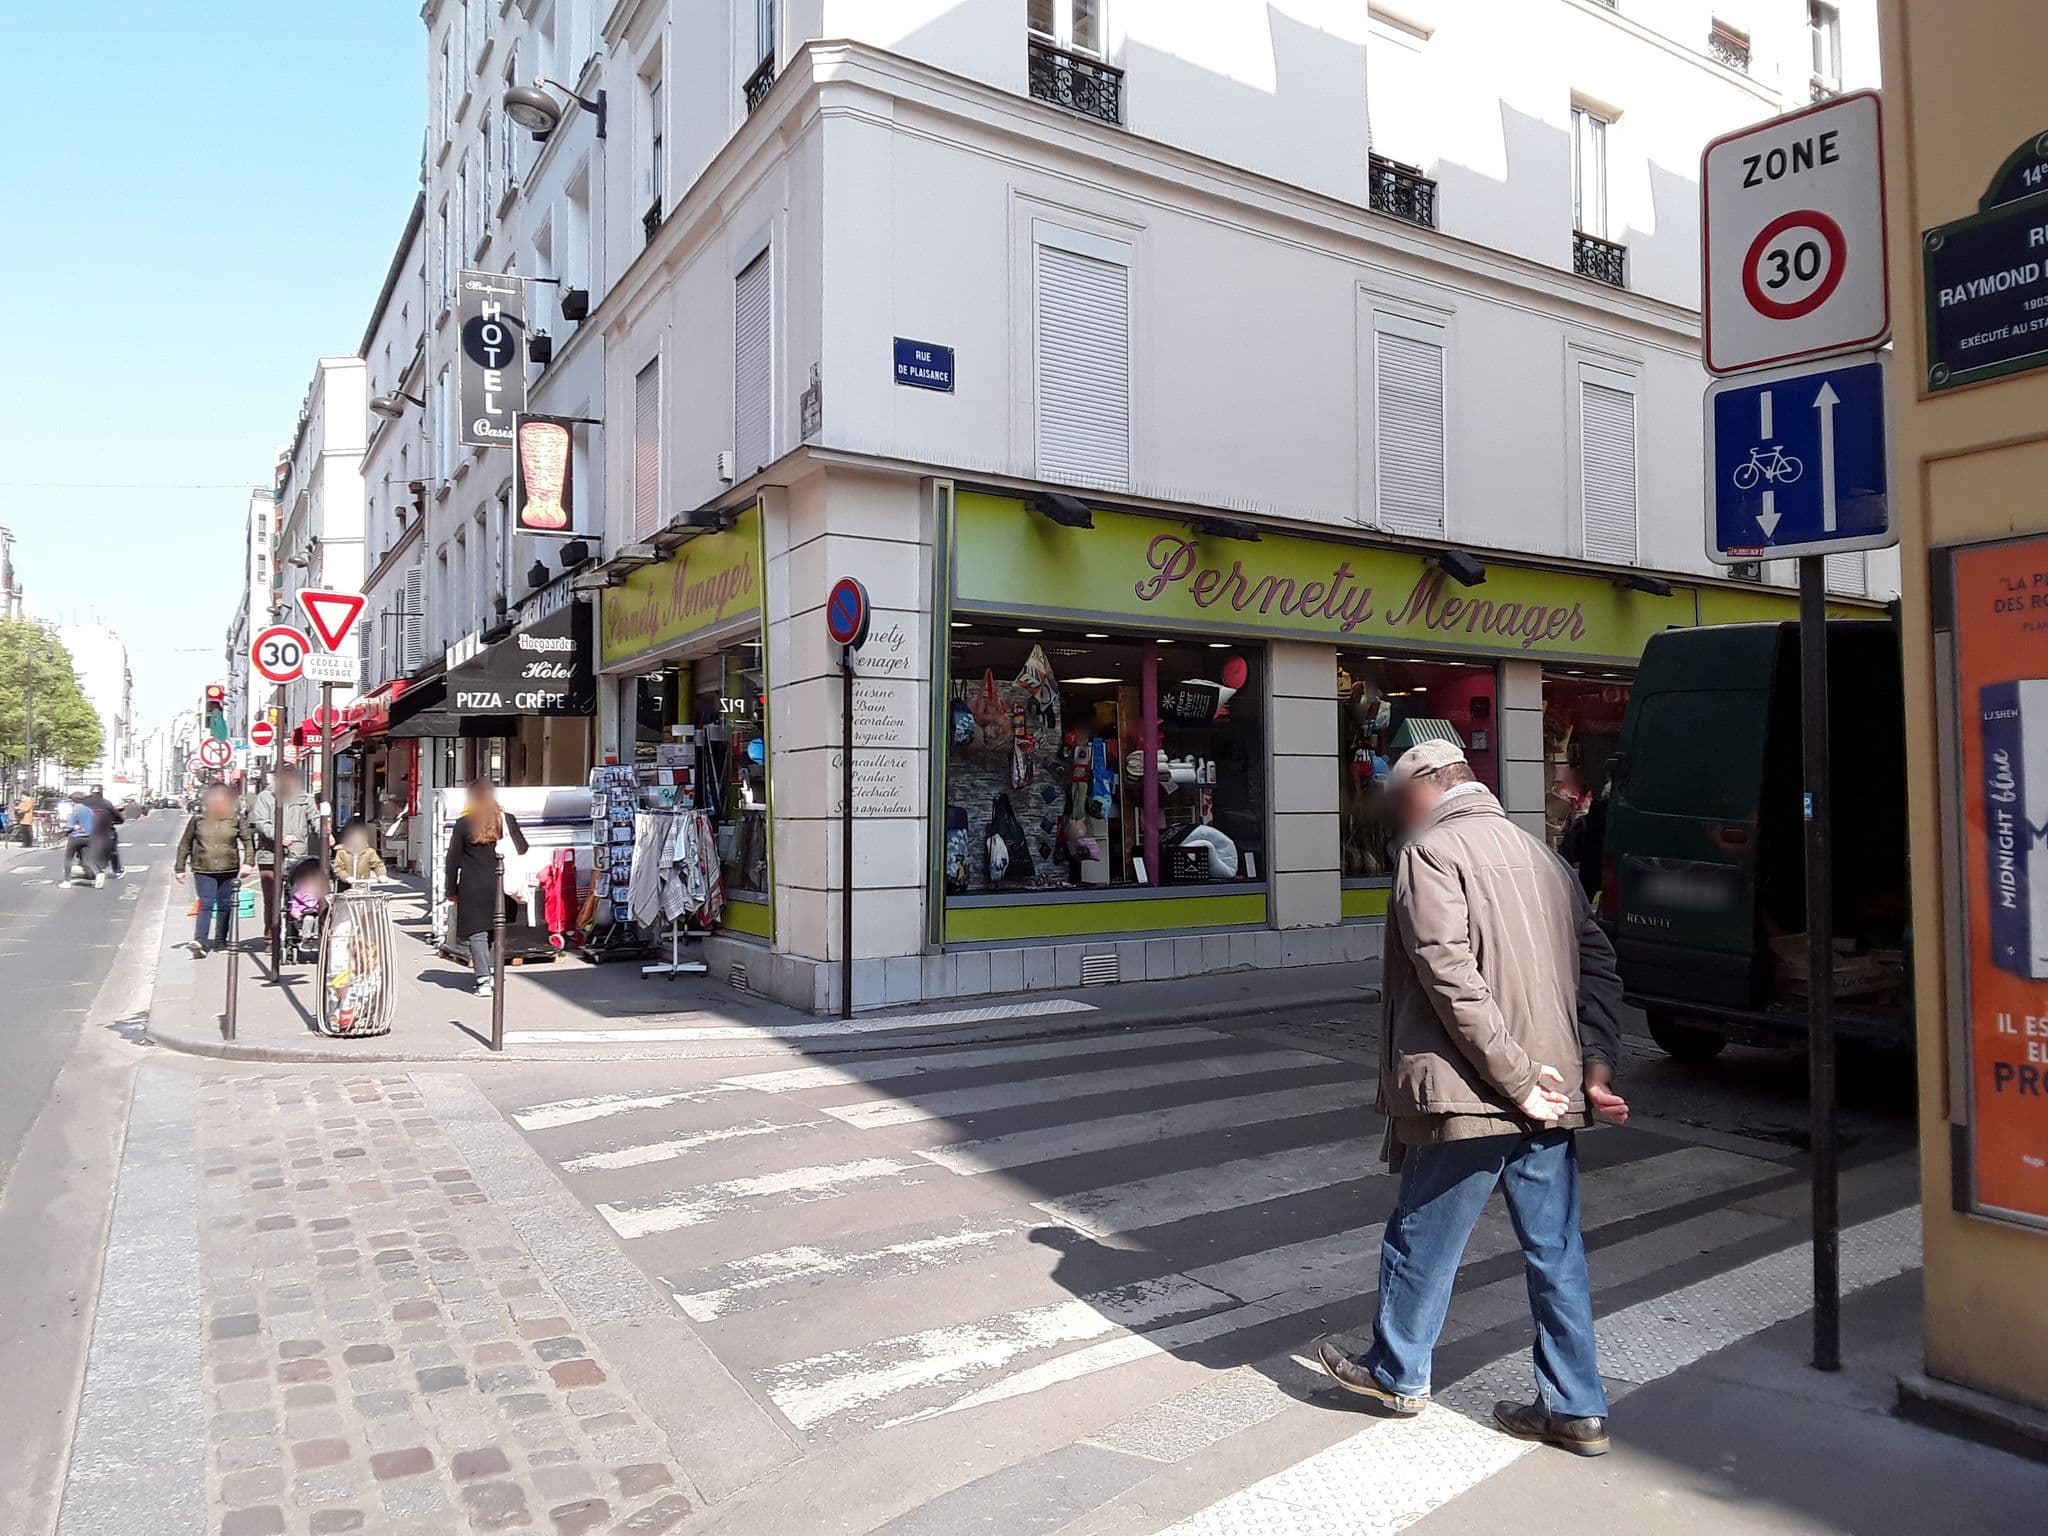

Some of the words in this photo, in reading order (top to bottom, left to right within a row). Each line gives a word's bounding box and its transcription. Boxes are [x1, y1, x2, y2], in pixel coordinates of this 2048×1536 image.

[1743, 130, 1840, 189] ZONE
[2029, 224, 2048, 248] R
[1766, 241, 1821, 289] 30
[1939, 262, 2040, 308] RAYMOND
[1960, 325, 2010, 350] EXÉCUTÉ
[2012, 323, 2028, 335] AU
[481, 300, 503, 415] HOTEL
[915, 350, 932, 363] RUE
[898, 364, 908, 376] DE
[909, 366, 950, 383] PLAISANCE
[606, 581, 660, 648] Pernety
[663, 552, 753, 625] Menager
[1135, 533, 1374, 633] Pernety
[1386, 567, 1588, 649] Menager
[1995, 596, 2024, 613] DES
[263, 642, 300, 667] 30
[311, 667, 352, 678] PASSAGE
[521, 661, 577, 679] Hôtel
[456, 692, 503, 709] PIZZA
[515, 689, 566, 709] CRÊPE
[853, 699, 887, 712] Bain
[853, 730, 900, 746] roguerie
[1989, 748, 2016, 803] blue
[1998, 809, 2017, 908] MIDNIGHT
[1626, 911, 1673, 929] RENAULT
[1998, 1012, 2018, 1034] IL
